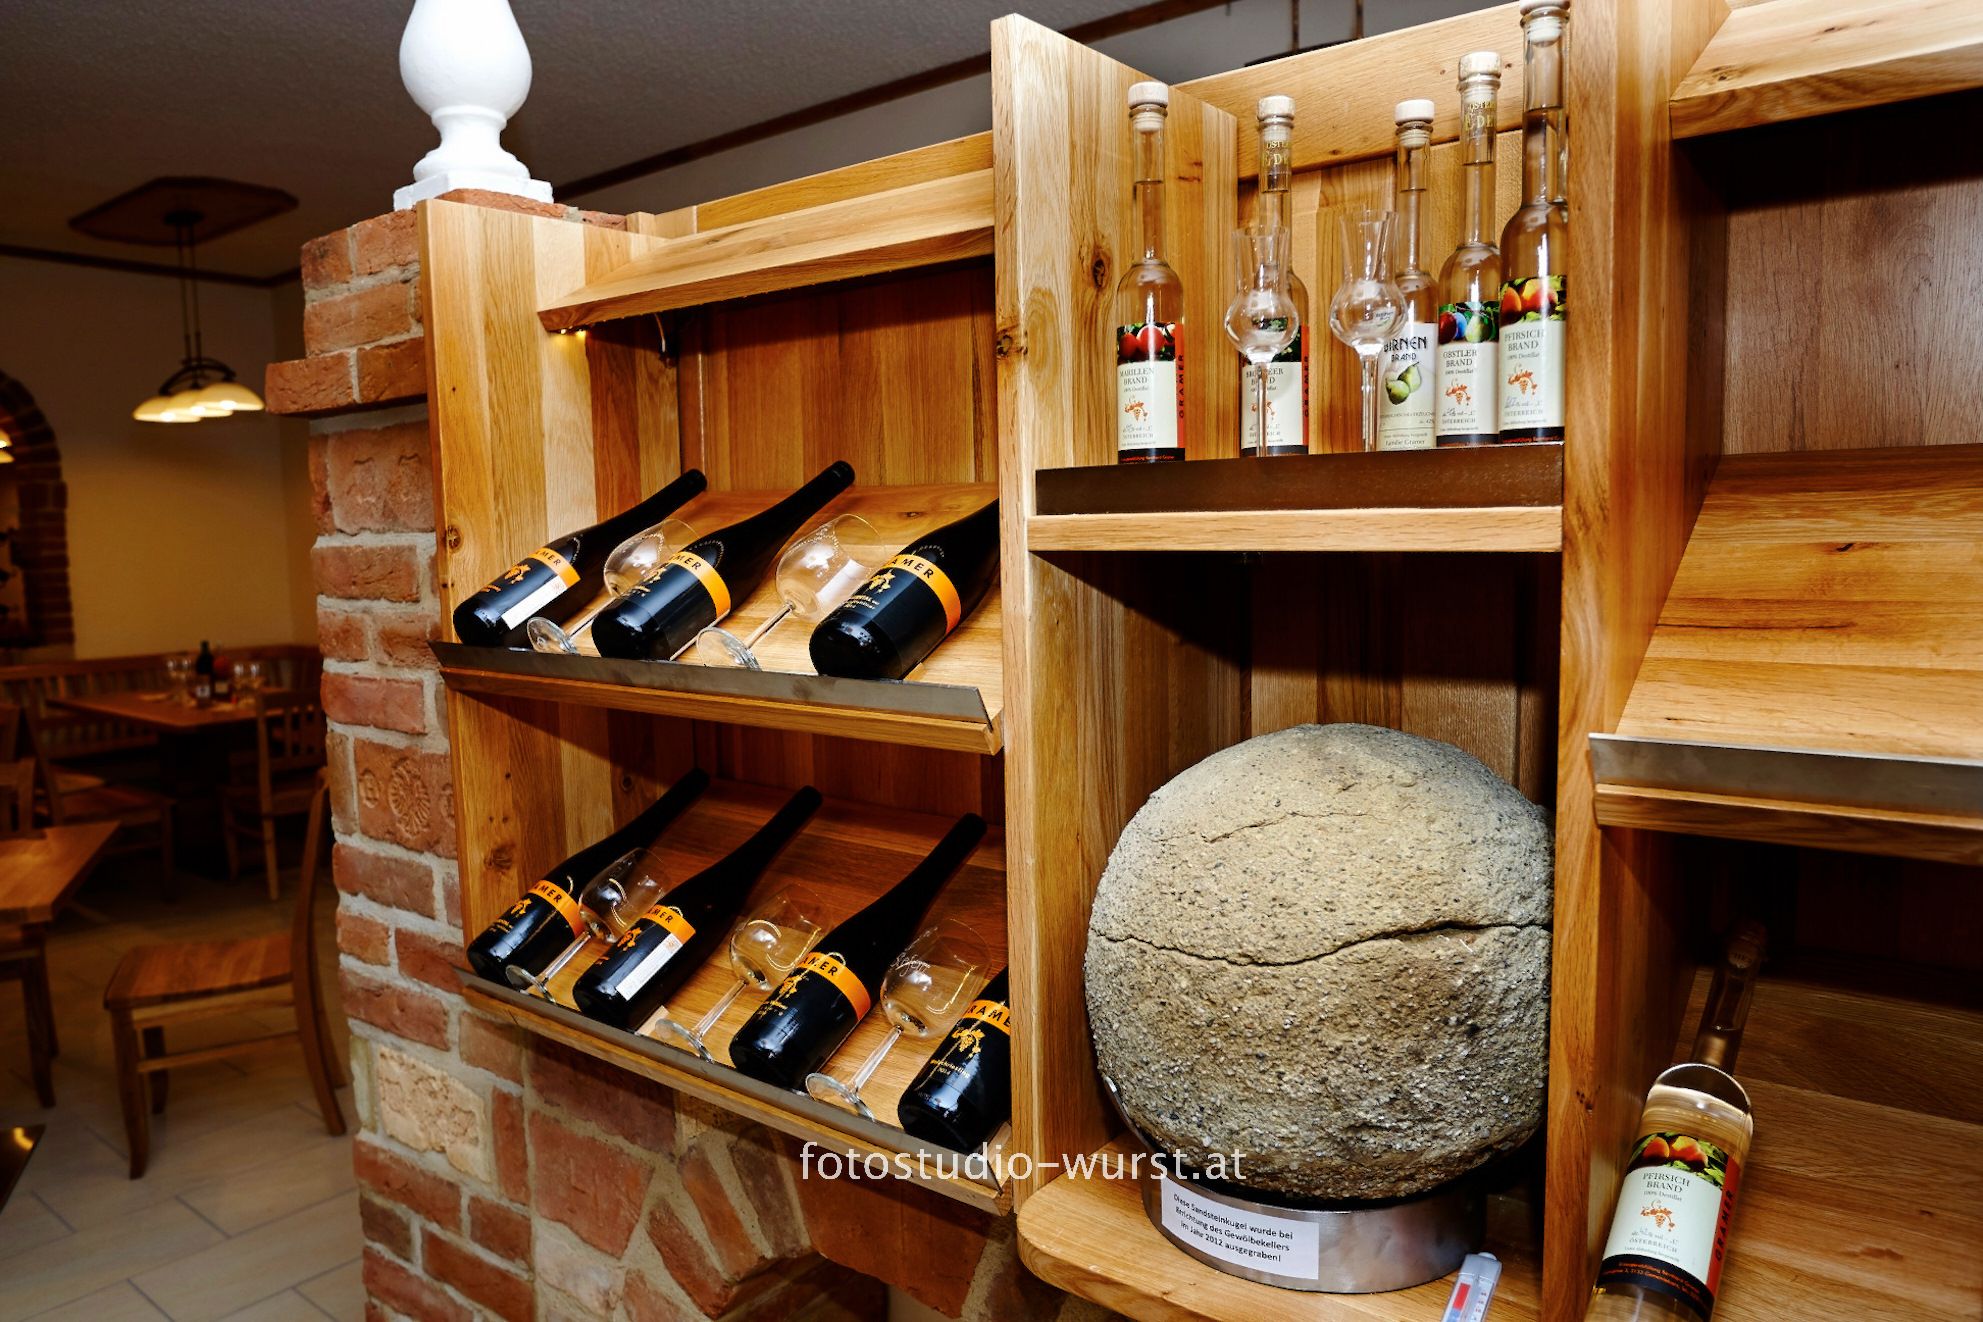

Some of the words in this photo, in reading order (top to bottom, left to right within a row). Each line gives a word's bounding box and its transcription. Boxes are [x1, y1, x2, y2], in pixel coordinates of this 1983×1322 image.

[1504, 329, 1544, 342] PFIRSICH
[1508, 341, 1539, 352] BRAND
[1391, 353, 1417, 363] BRAND
[1443, 349, 1477, 359] OBSTLER
[1446, 359, 1473, 368] BRAND
[1120, 367, 1154, 377] MARILLEN
[1123, 376, 1148, 386] BRAND
[1642, 1172, 1690, 1187] PFIRSICH
[1646, 1180, 1683, 1193] BRAND
[1173, 1193, 1190, 1209] Diese
[1191, 1203, 1248, 1230] Sandsteinkugel
[1249, 1225, 1277, 1238] wurde
[1278, 1229, 1293, 1241] bei
[1175, 1206, 1209, 1231] Errichtung
[1209, 1224, 1223, 1235] des
[1224, 1229, 1290, 1252] Gewölbekellers
[1712, 1189, 1734, 1262] GRAMER
[1190, 1224, 1204, 1238] Jahr
[1205, 1233, 1223, 1248] 2012
[1225, 1243, 1282, 1263] ausgegraben!
